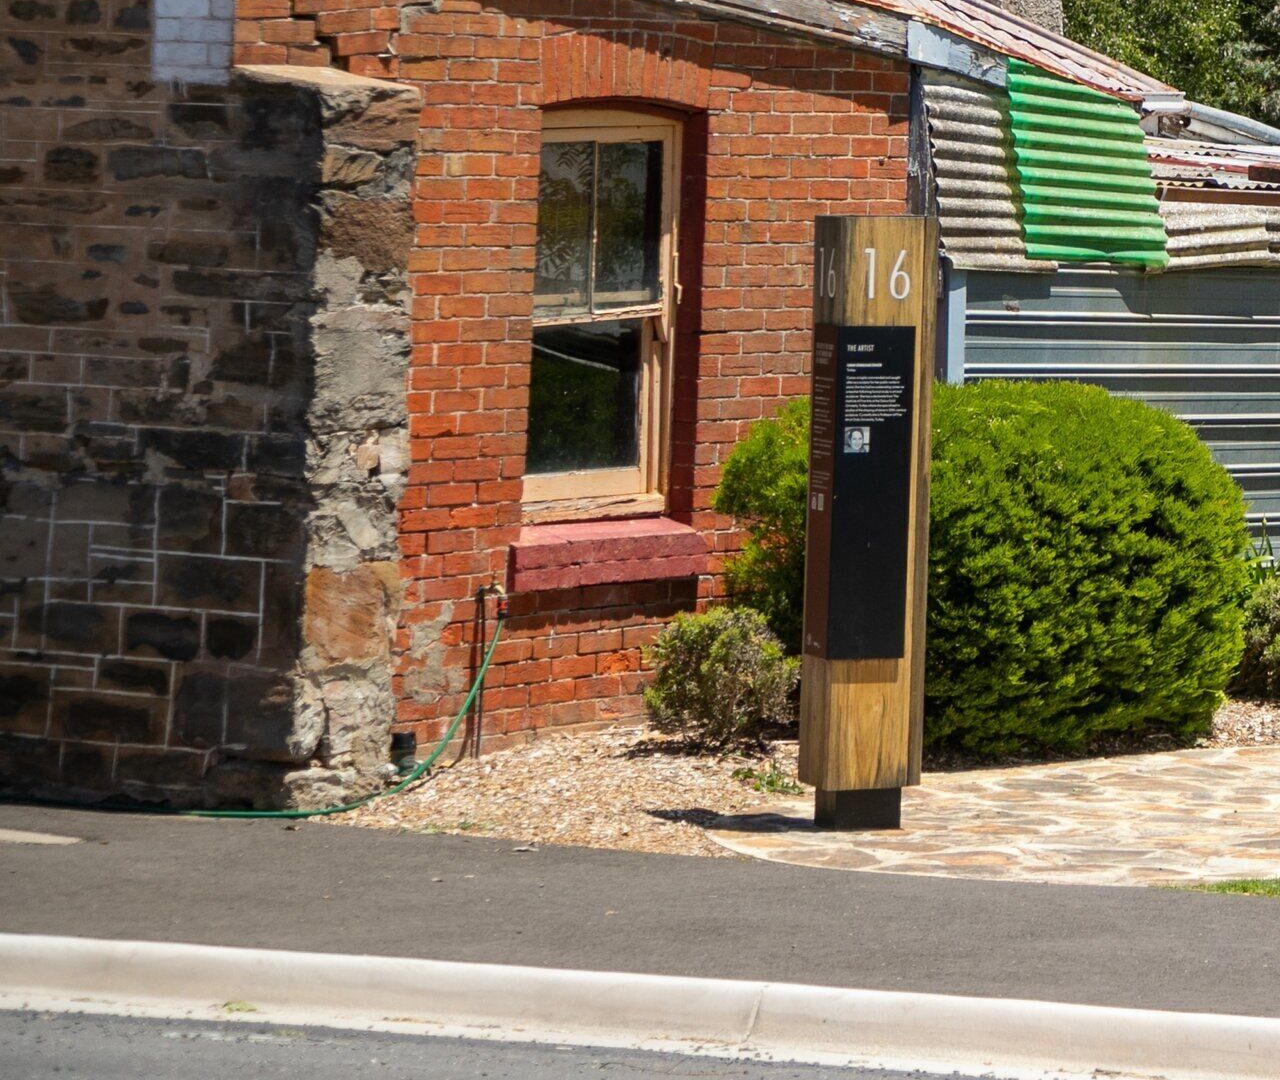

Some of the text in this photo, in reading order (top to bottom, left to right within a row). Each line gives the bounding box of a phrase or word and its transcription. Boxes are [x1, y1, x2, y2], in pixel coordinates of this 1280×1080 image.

[820, 247, 836, 298] 16
[864, 247, 911, 300] 16
[847, 344, 875, 352] THE ARTIST
